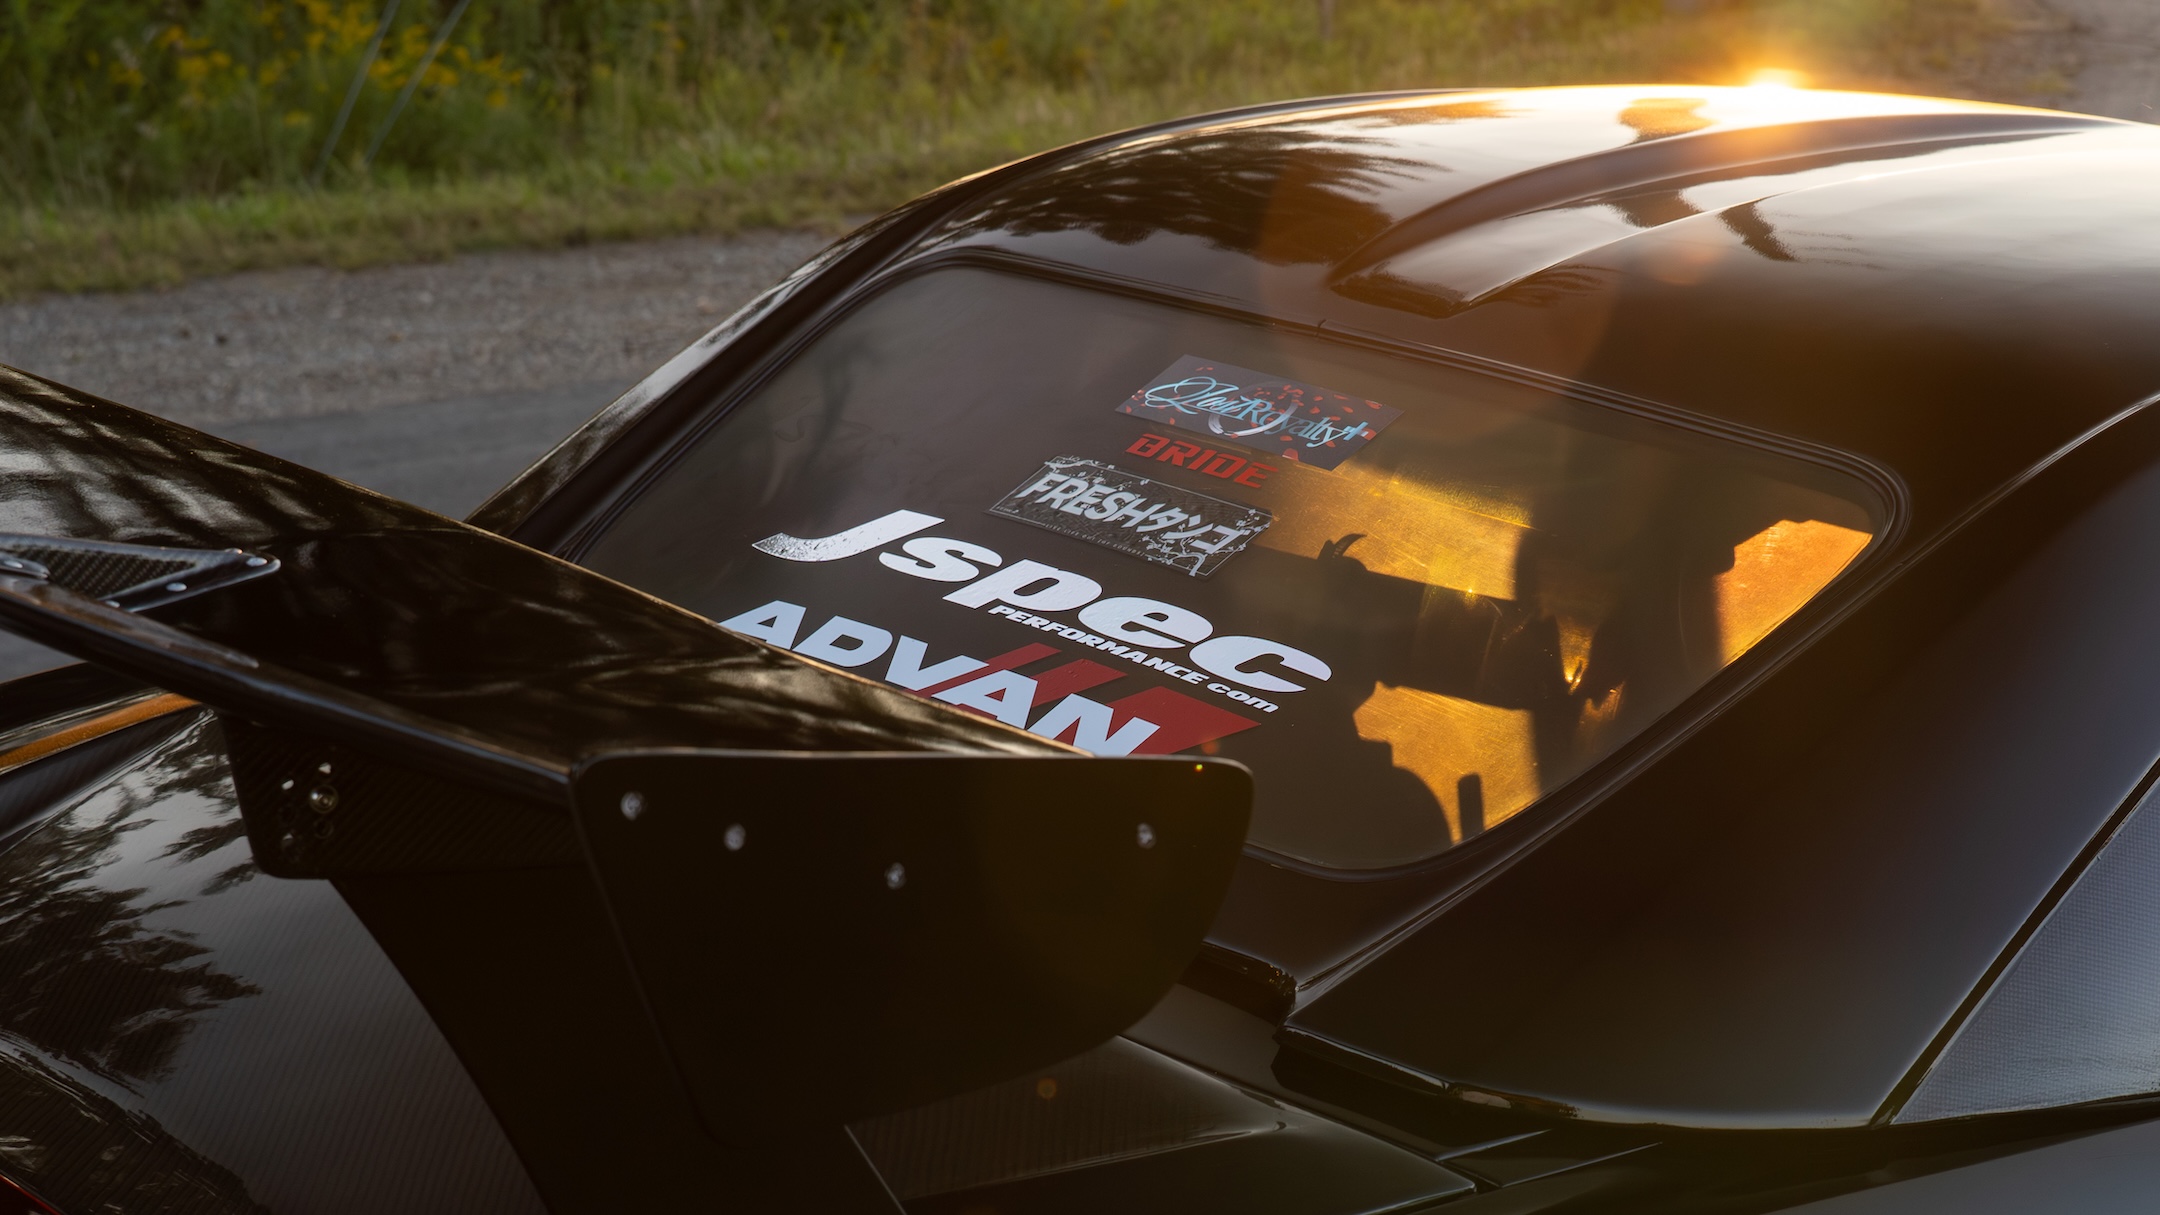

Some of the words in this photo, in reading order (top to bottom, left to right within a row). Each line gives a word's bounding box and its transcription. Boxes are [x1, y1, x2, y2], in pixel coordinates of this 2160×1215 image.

[1126, 433, 1279, 489] BRIDE
[752, 509, 1333, 693] Jspec
[988, 605, 1210, 685] PERFORMANCE
[717, 600, 1161, 756] ADVAN
